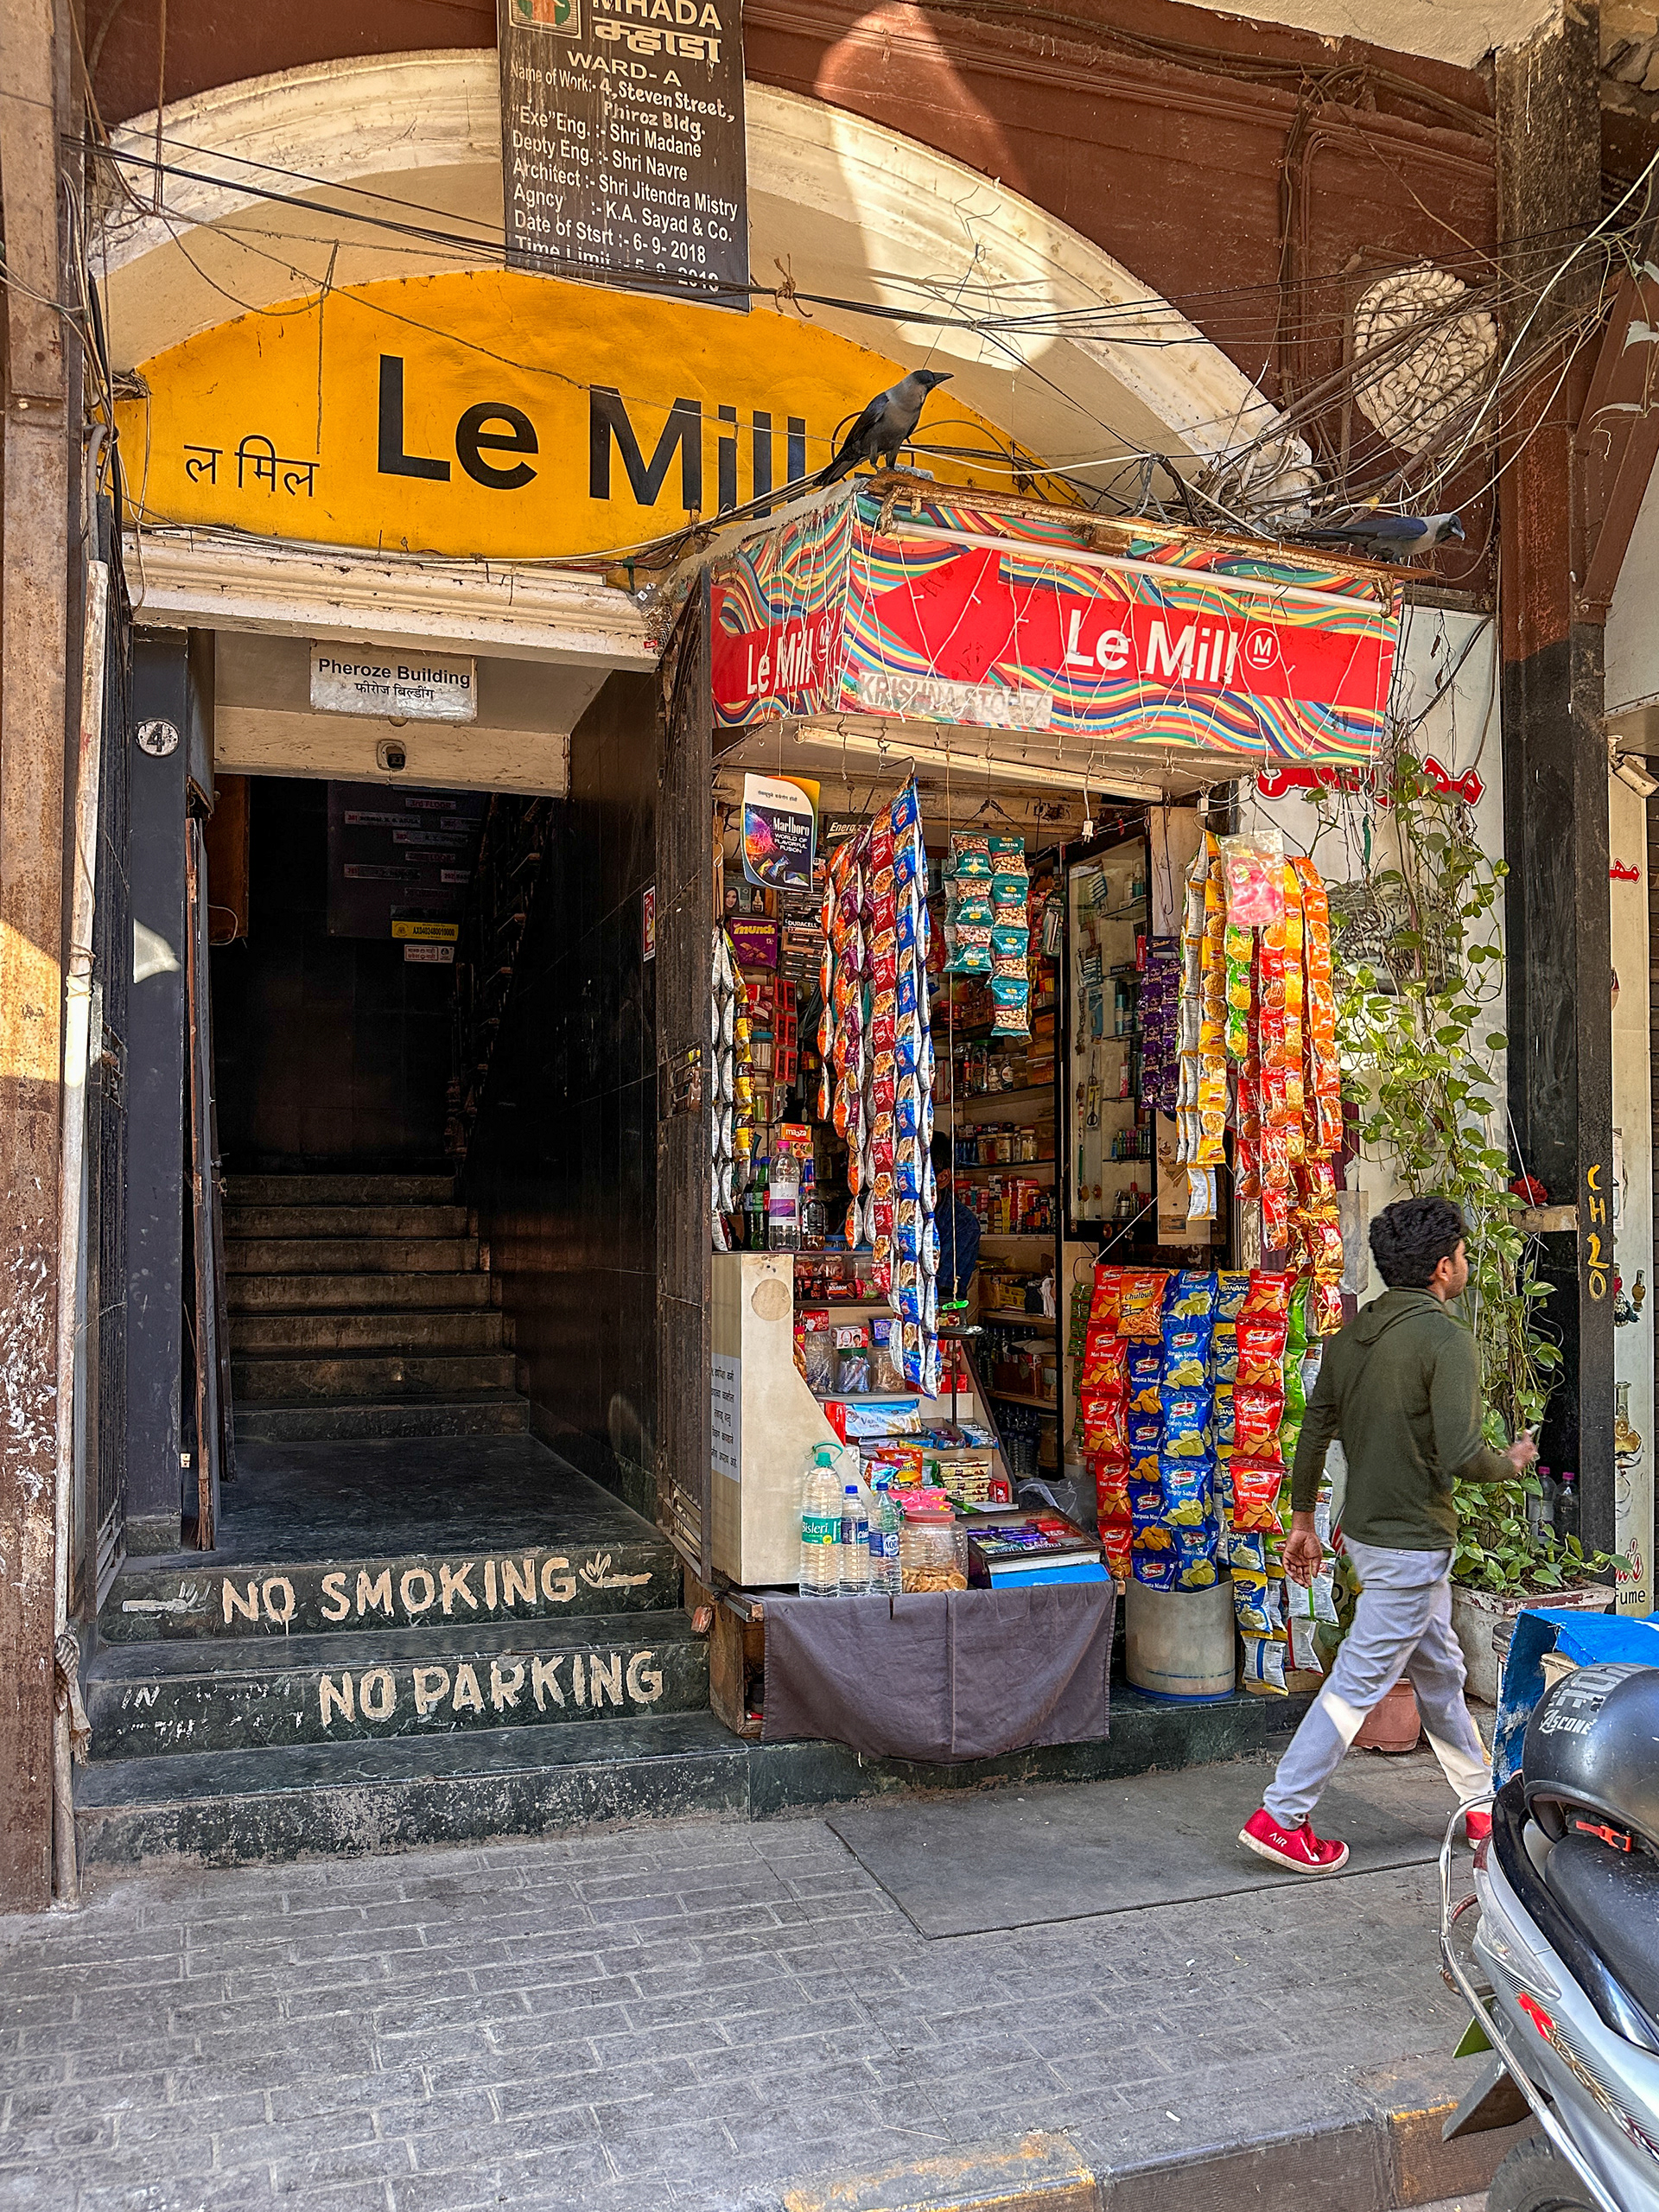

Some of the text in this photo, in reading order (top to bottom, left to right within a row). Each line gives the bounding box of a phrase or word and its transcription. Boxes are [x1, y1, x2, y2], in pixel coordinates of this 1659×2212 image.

[510, 60, 543, 84] Name
[545, 67, 557, 86] of
[663, 70, 683, 87] A
[604, 101, 706, 142] Phiroz Bldg.
[610, 123, 640, 147] Shri
[645, 130, 702, 159] Madane
[561, 141, 594, 168] Eng.
[612, 149, 642, 173] Shri
[647, 157, 688, 181] Navre
[512, 158, 582, 188] Architect
[599, 175, 629, 198] Shri
[632, 181, 691, 210] Jitendra
[695, 193, 738, 222] Mistry
[512, 183, 564, 213] Agncy
[606, 200, 638, 225] K.A.
[642, 207, 689, 237] Sayad
[692, 218, 702, 236] &
[708, 221, 734, 242] Co.
[514, 210, 550, 234] Date
[556, 219, 571, 238] of
[671, 238, 707, 264] 2018
[378, 353, 806, 519] Le Mill
[234, 434, 321, 497] मिल
[747, 643, 771, 695] Le
[775, 627, 814, 690] Mill
[1067, 608, 1129, 671] Le
[1146, 620, 1239, 685] Mill
[318, 658, 471, 690] Pheroze Building
[354, 680, 391, 696] फीरोज
[146, 722, 164, 753] 4
[772, 816, 810, 836] Marlboro
[774, 833, 798, 842] WORLD
[779, 845, 803, 854] FUSION
[733, 924, 776, 935] munch
[787, 919, 818, 929] DURACELL
[802, 1522, 829, 1534] Bisleri
[221, 1556, 578, 1629] NO SMOKING
[319, 1667, 397, 1728] NO
[413, 1649, 664, 1716] PARKING
[1268, 1832, 1288, 1847] AIR
